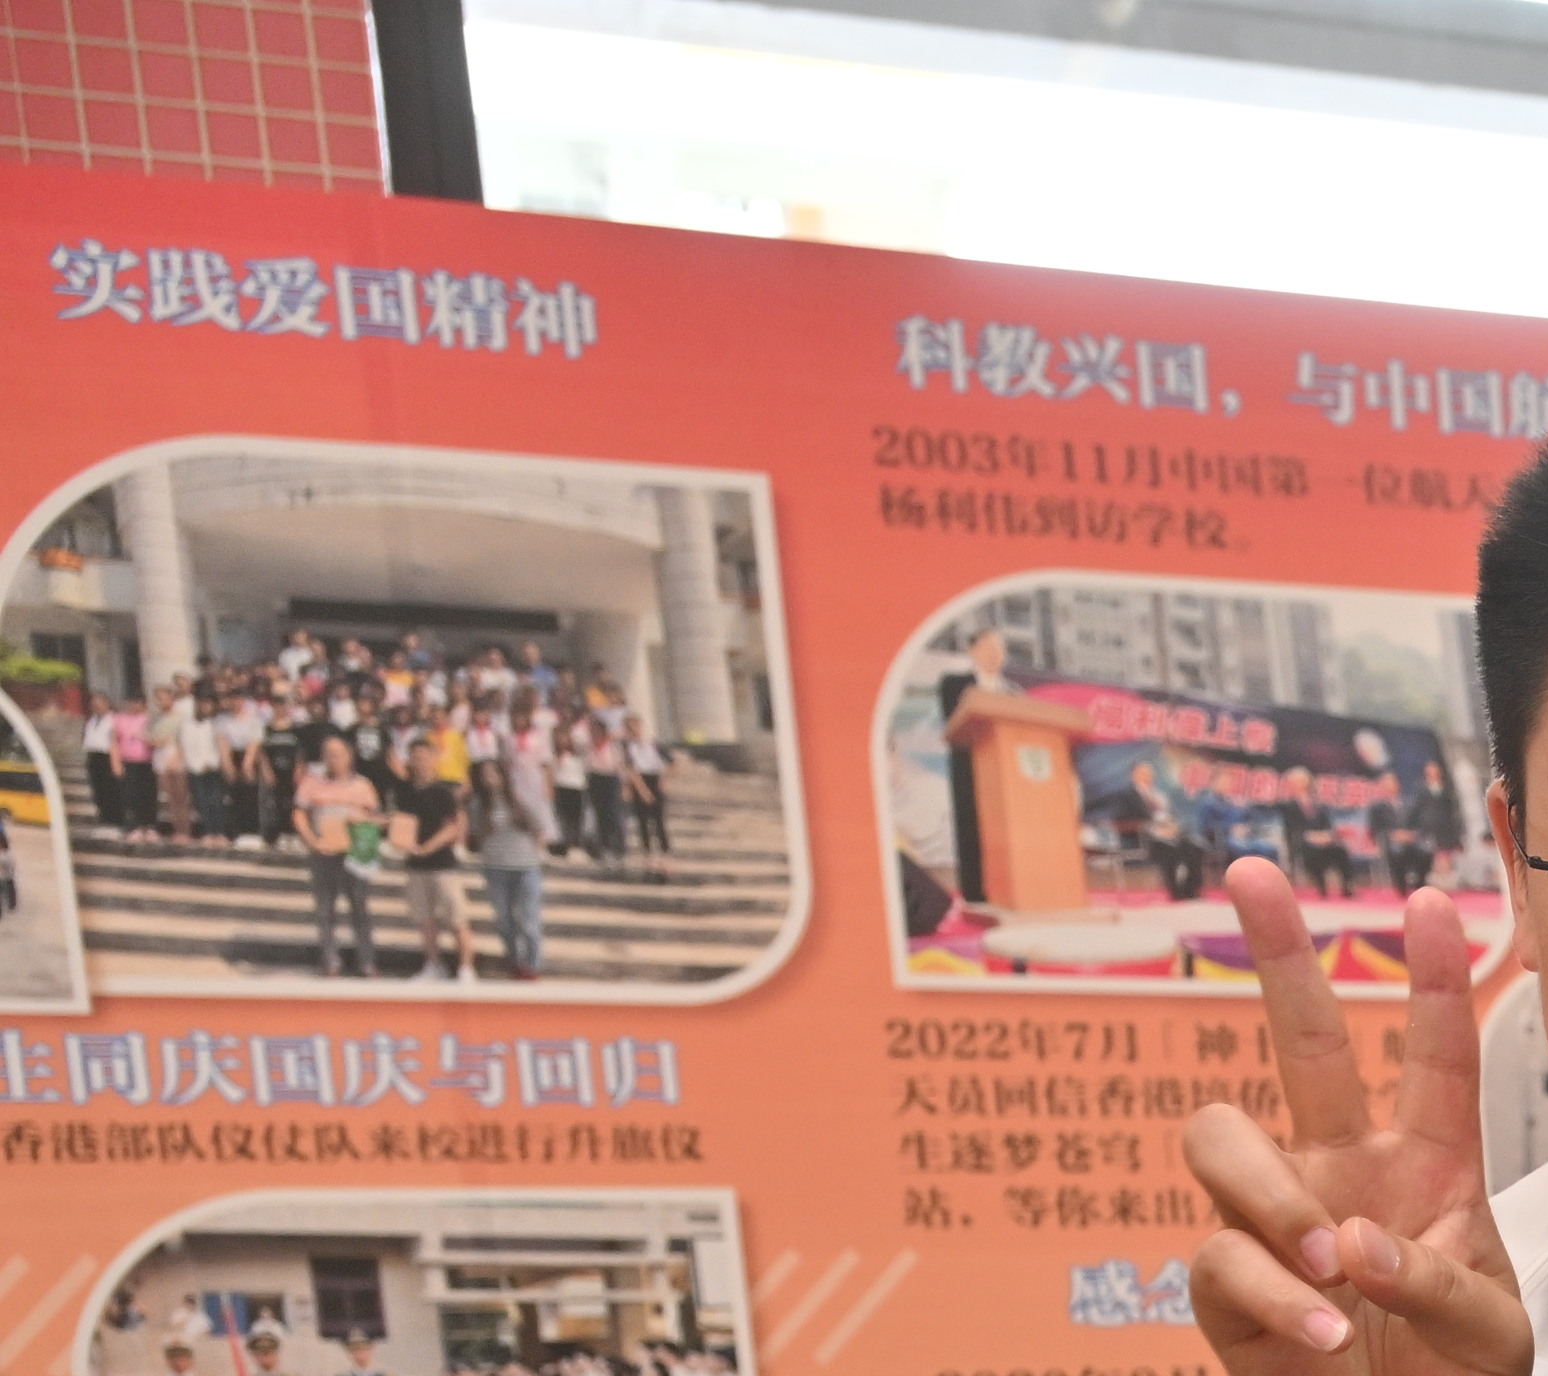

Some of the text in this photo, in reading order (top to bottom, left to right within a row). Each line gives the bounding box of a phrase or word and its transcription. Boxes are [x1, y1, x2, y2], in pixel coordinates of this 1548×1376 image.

[48, 237, 600, 360] 实践爱国精神
